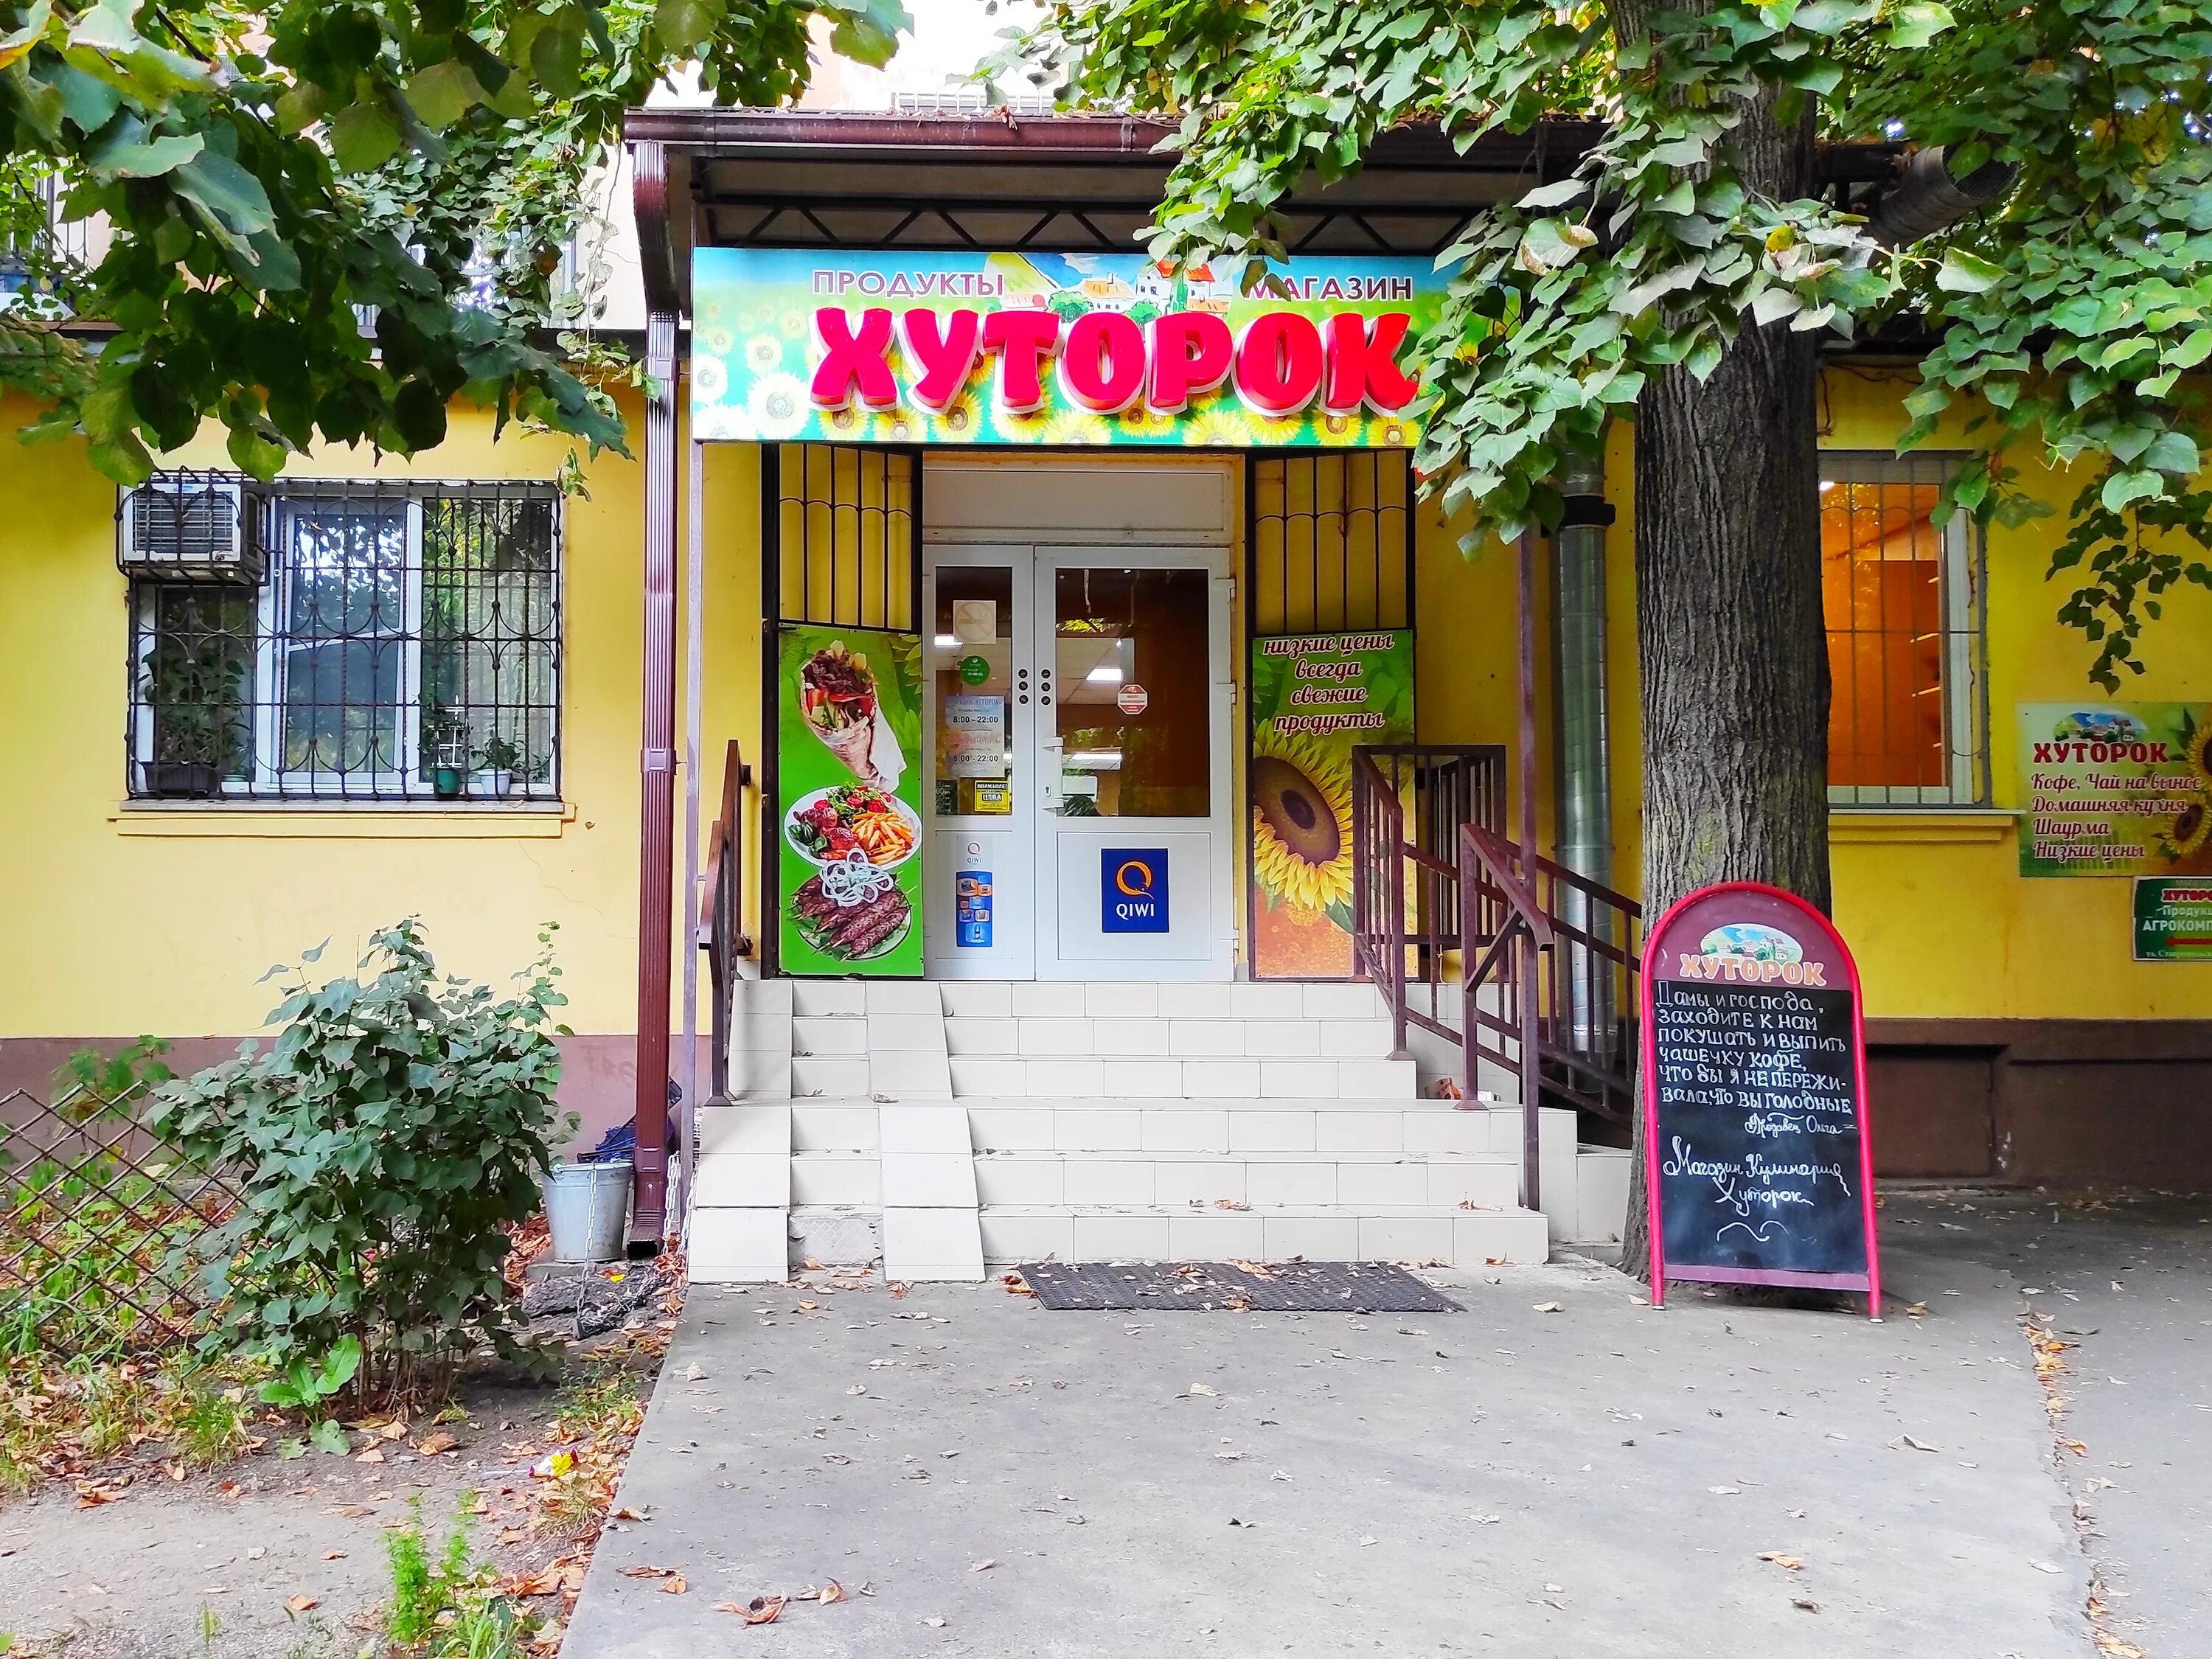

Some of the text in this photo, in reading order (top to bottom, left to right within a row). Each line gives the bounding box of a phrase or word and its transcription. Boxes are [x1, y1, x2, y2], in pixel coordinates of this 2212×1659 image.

[813, 270, 1004, 298] ПРОДУКТЫ
[1244, 276, 1413, 300] МАГАЗИН
[810, 307, 1418, 413] ХУТОРОК
[1263, 633, 1394, 658] низкие цены
[1295, 659, 1362, 683] всегда
[1291, 684, 1368, 705] свежие
[1274, 713, 1385, 737] продукты
[2033, 742, 2168, 764] ХУТОРОК
[2085, 773, 2121, 790] Чай
[2125, 776, 2146, 790] на
[2150, 773, 2200, 790] вынос
[2031, 796, 2188, 816] Домашняя кухня
[2033, 818, 2110, 839] Шаурма
[2034, 841, 2146, 863] Низкие цены
[1116, 903, 1155, 920] QIWI
[1679, 953, 1826, 987] ХУТОРОК
[1656, 981, 1709, 1008] Дамы
[1716, 995, 1726, 1006] и
[1663, 1135, 1744, 1183] Магазин
[1712, 1177, 1814, 1217] Хуторок
